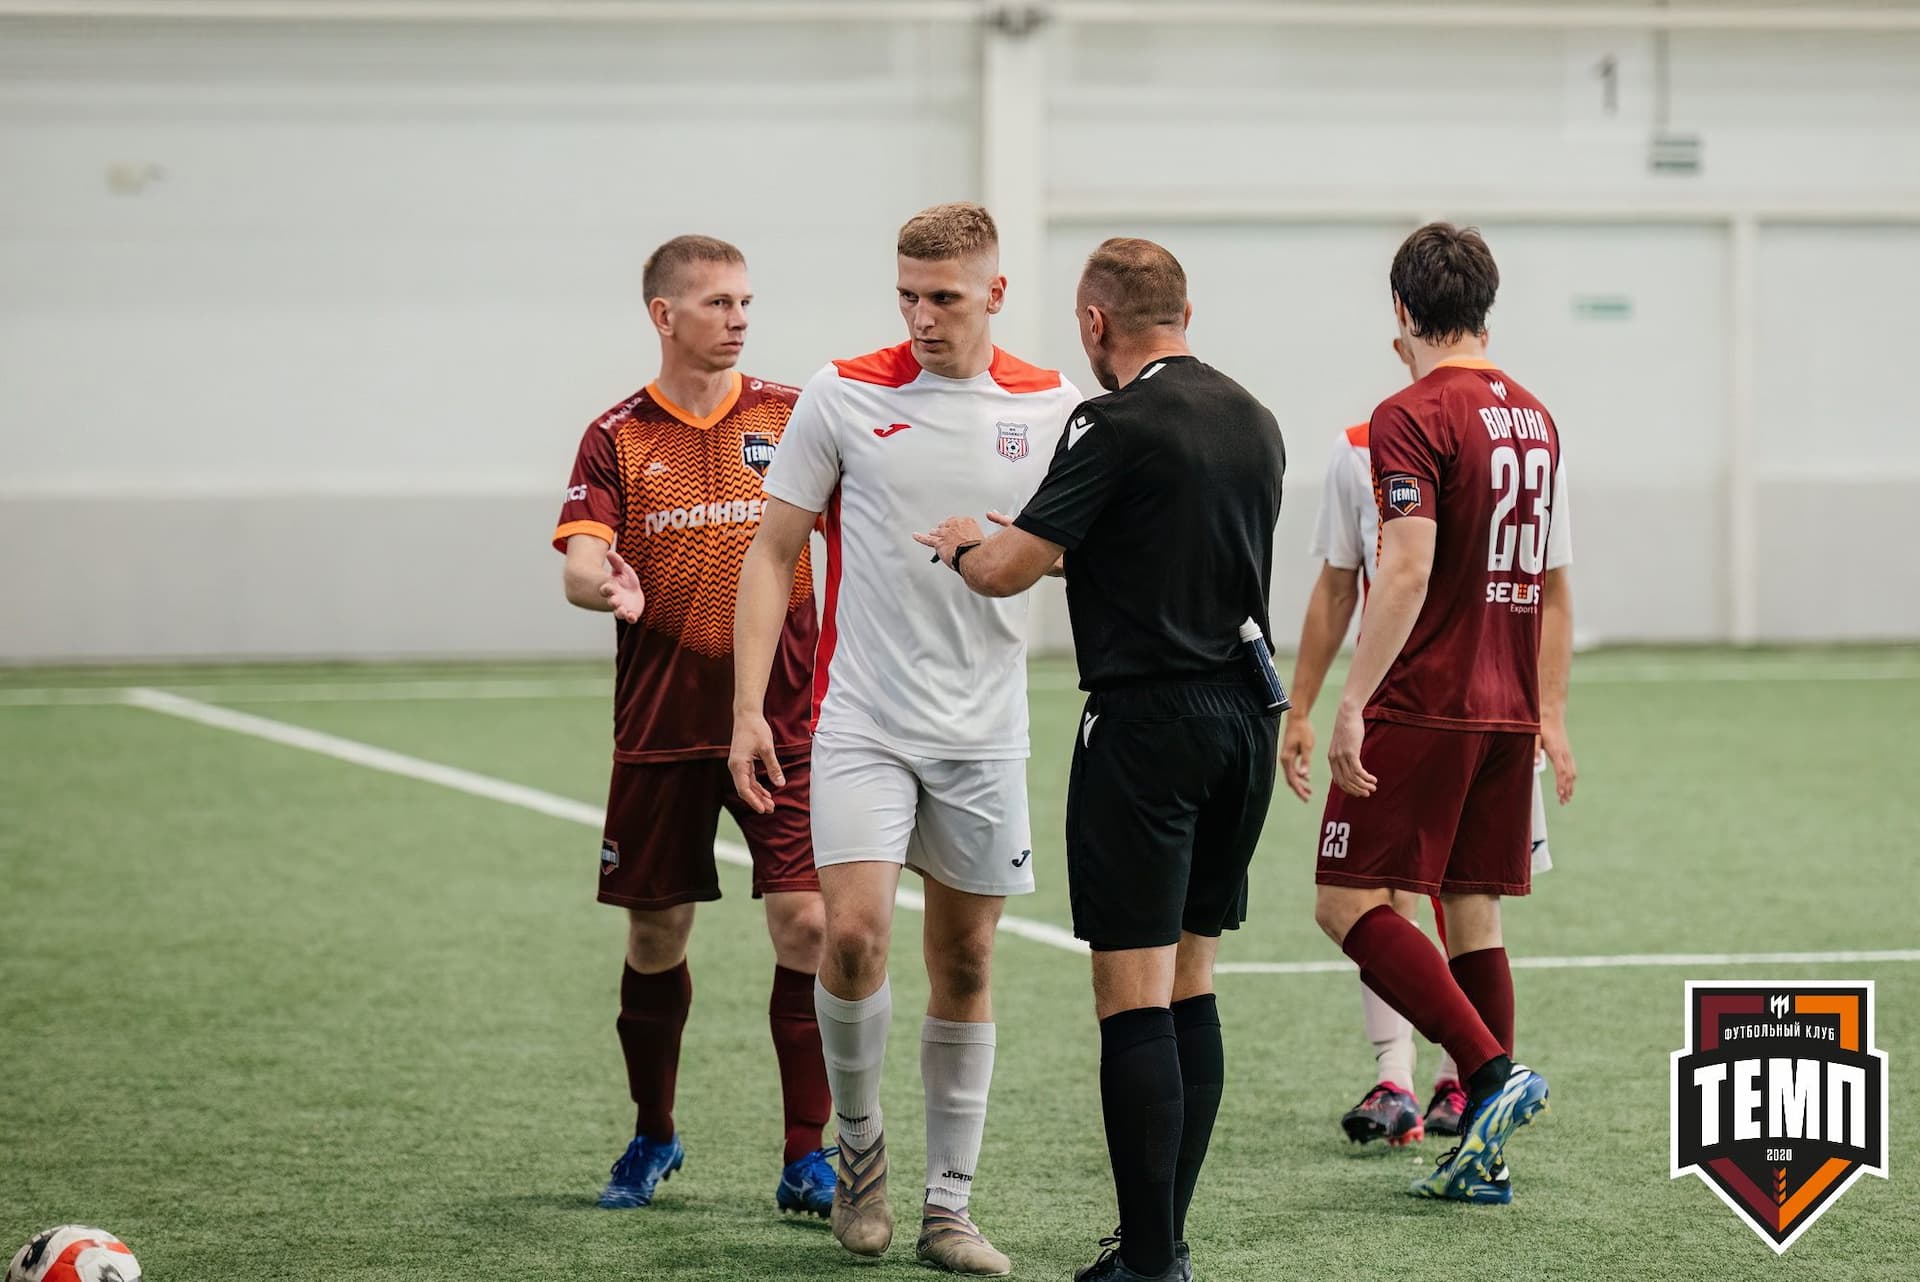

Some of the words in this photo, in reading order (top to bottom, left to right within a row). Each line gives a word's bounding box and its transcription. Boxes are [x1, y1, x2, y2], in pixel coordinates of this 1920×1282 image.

[1588, 53, 1619, 119] 1
[1478, 406, 1549, 444] ВОРОНА
[1392, 487, 1418, 503] ТЕМП
[1488, 446, 1551, 575] 23
[1321, 821, 1350, 859] 23
